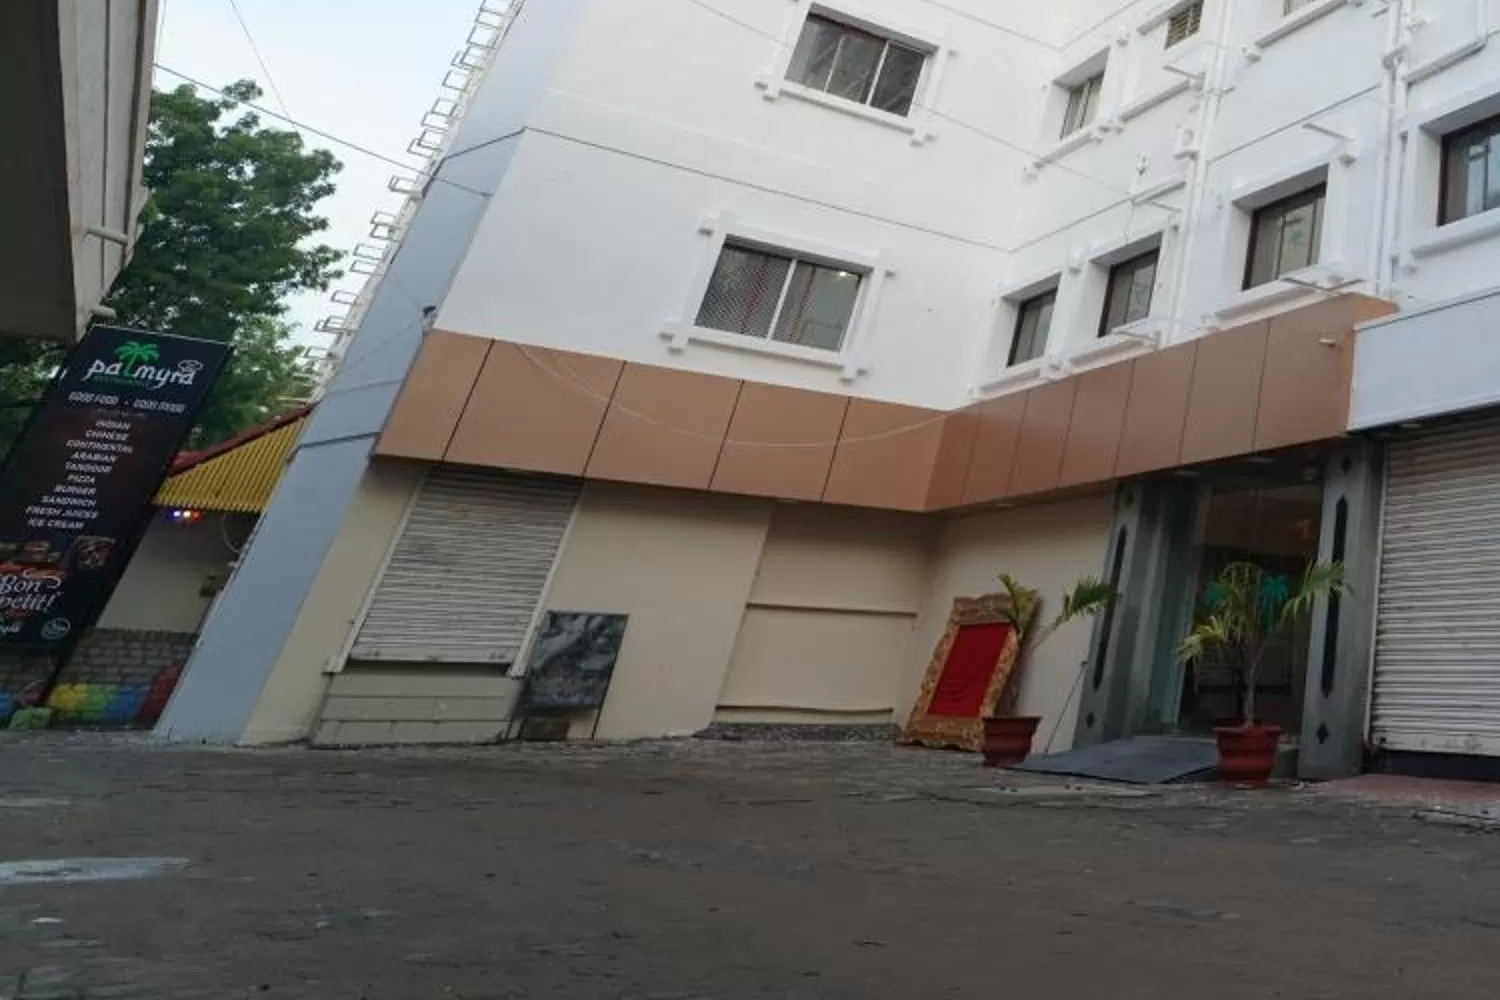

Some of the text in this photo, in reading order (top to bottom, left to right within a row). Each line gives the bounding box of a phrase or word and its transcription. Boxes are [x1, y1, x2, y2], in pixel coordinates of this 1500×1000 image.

[95, 419, 131, 430] INDIAN
[84, 429, 129, 440] CHINESE
[65, 440, 133, 454] CONTINENTAL
[71, 451, 119, 463] ARABIAN
[67, 474, 95, 484] PIZZA
[54, 484, 97, 495] BURGER
[41, 495, 97, 507] SANDWICH
[25, 505, 61, 516] FRESH
[27, 518, 84, 529] ICE CREAM
